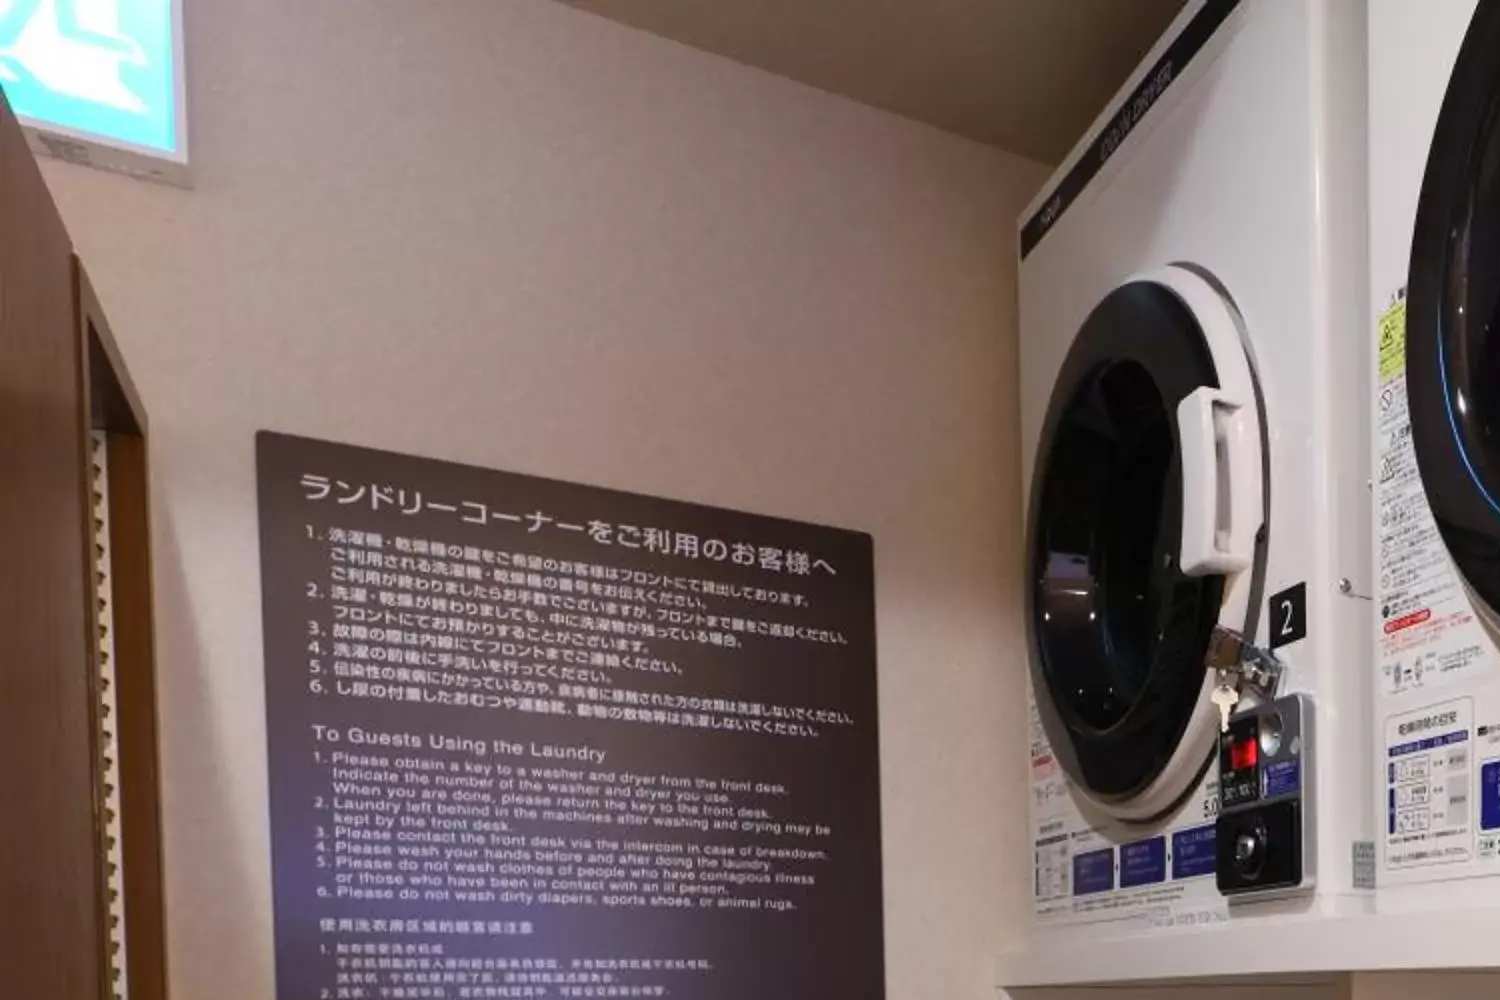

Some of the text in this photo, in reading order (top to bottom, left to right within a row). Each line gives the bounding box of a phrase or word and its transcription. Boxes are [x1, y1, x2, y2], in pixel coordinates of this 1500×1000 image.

[299, 472, 836, 580] ランドリーコーナーをご利用のお客様へ
[1281, 600, 1293, 636] 2
[311, 724, 605, 765] To Guests Using the Laundry
[332, 752, 750, 791] Please obtain key washer and dryer from the front
[332, 767, 699, 803] Indicate the number the washer and dryer you
[332, 782, 380, 797] When
[387, 786, 415, 801] you
[422, 788, 446, 800] are
[501, 792, 550, 808] please
[557, 795, 598, 809] return
[604, 798, 626, 810] the
[631, 800, 654, 814] key
[677, 802, 698, 814] the
[703, 804, 733, 816] front
[332, 812, 466, 830] kept the front
[333, 798, 811, 835] Laundry left behind the machines after washing and drying may
[334, 826, 734, 855] Please contact the front desk via the intercom case
[335, 841, 717, 868] Please wash your hands before and after doing the
[335, 856, 815, 884] Please not wash clothes people who have contagious illness
[359, 872, 403, 885] those
[410, 873, 441, 886] who
[447, 875, 484, 887] have
[490, 876, 527, 888] been
[551, 878, 603, 890] contact
[609, 880, 637, 891] with
[663, 881, 674, 892] ill
[336, 887, 392, 900] Please
[425, 889, 449, 901] not
[456, 890, 494, 902] wash
[501, 891, 532, 905] dirty
[602, 893, 645, 907] sports
[717, 896, 760, 908] animal
